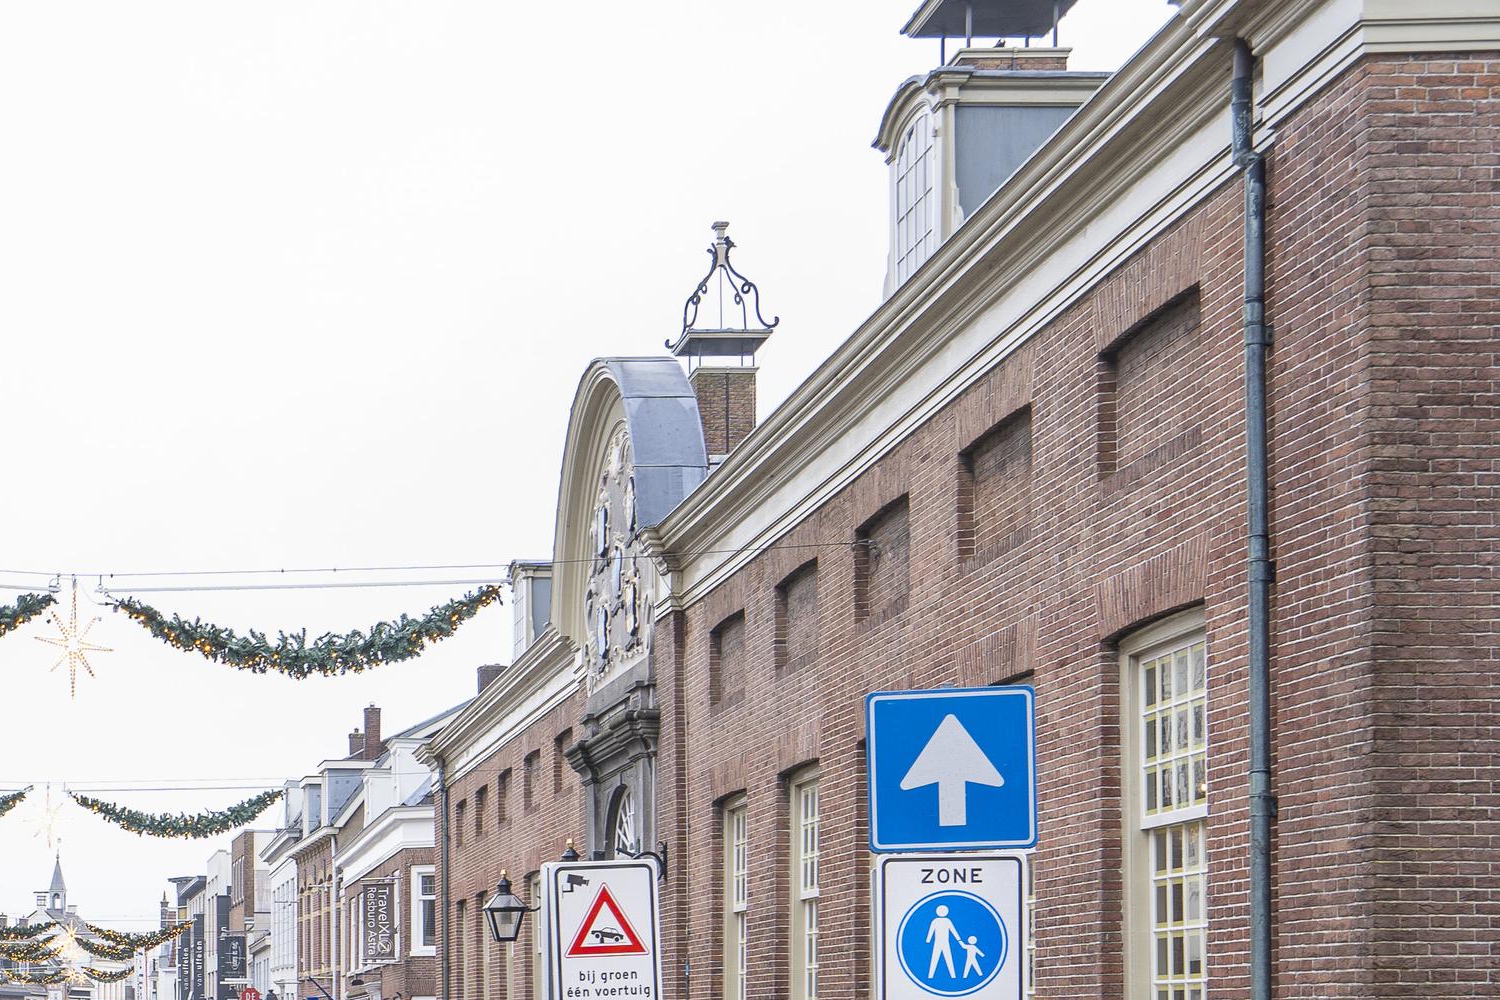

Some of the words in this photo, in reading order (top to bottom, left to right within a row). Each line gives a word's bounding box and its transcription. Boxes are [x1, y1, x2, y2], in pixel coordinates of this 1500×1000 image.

[921, 868, 983, 885] ZONE
[367, 887, 377, 927] Reisburo
[367, 931, 377, 955] Astra
[579, 970, 596, 984] bij
[600, 971, 638, 984] groen
[567, 986, 590, 998] één
[595, 984, 651, 998] voertuig
